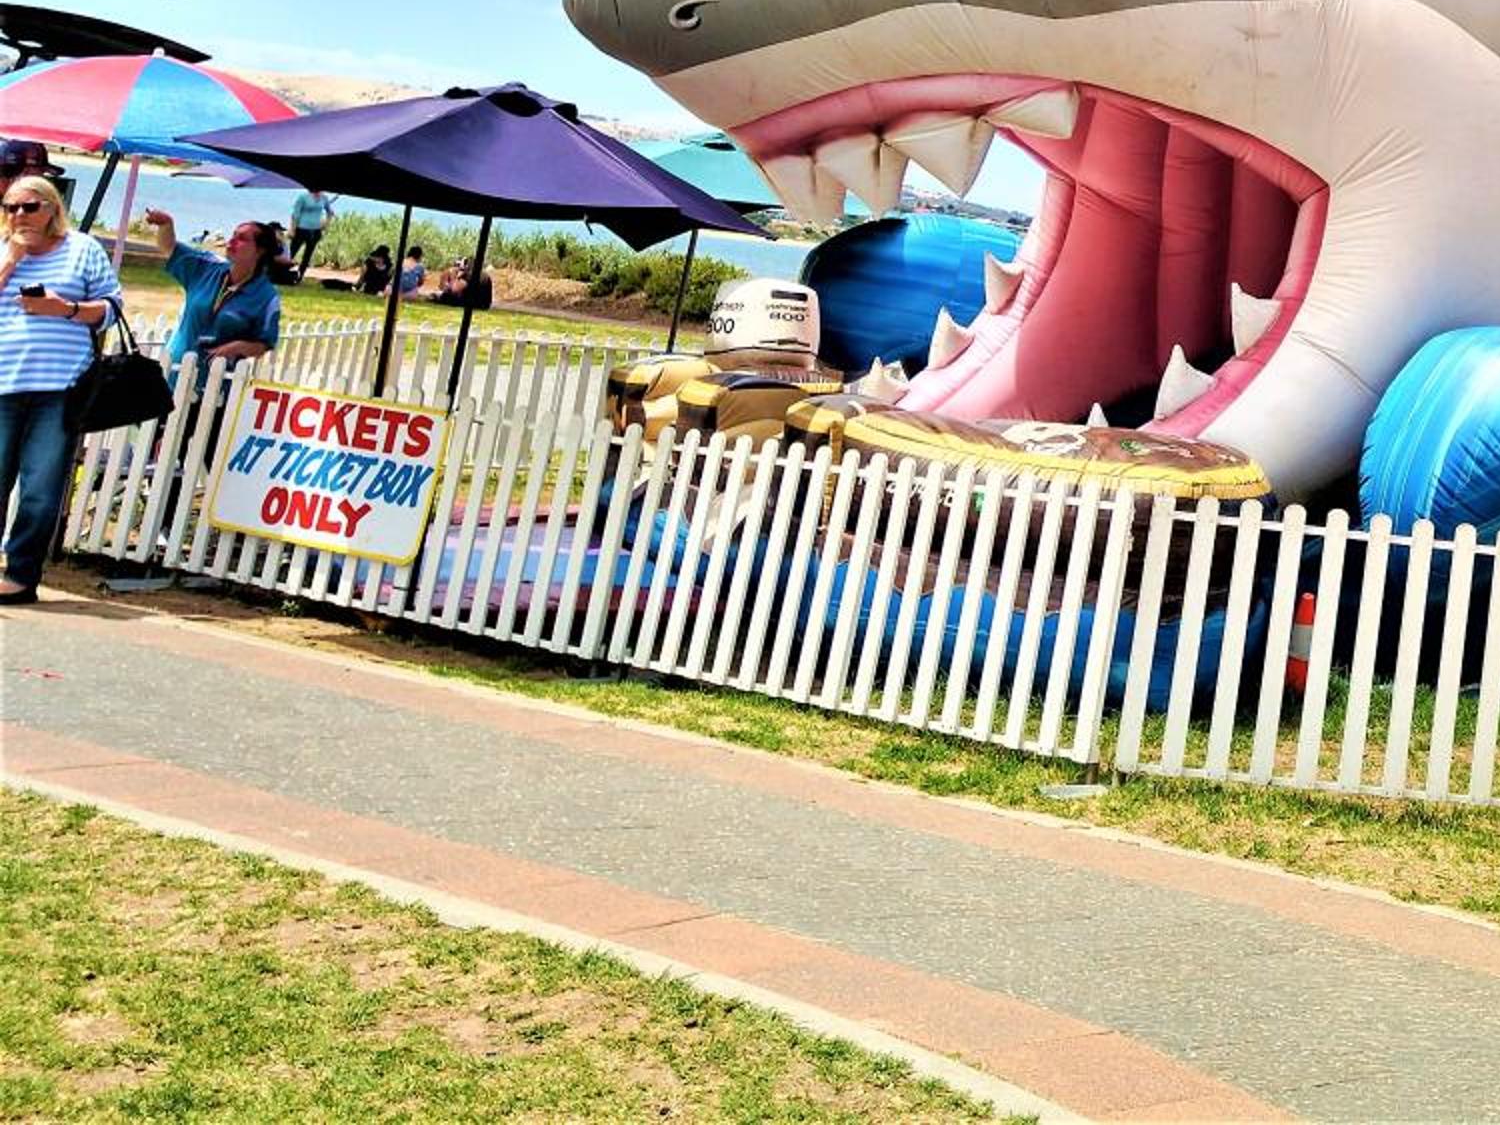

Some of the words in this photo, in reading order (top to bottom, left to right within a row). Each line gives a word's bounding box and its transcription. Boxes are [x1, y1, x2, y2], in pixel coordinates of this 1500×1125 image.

[252, 388, 434, 457] TICKETS
[227, 435, 275, 475] AT
[269, 440, 379, 496] TICKET
[364, 459, 434, 507] BOX
[261, 486, 372, 537] ONLY
